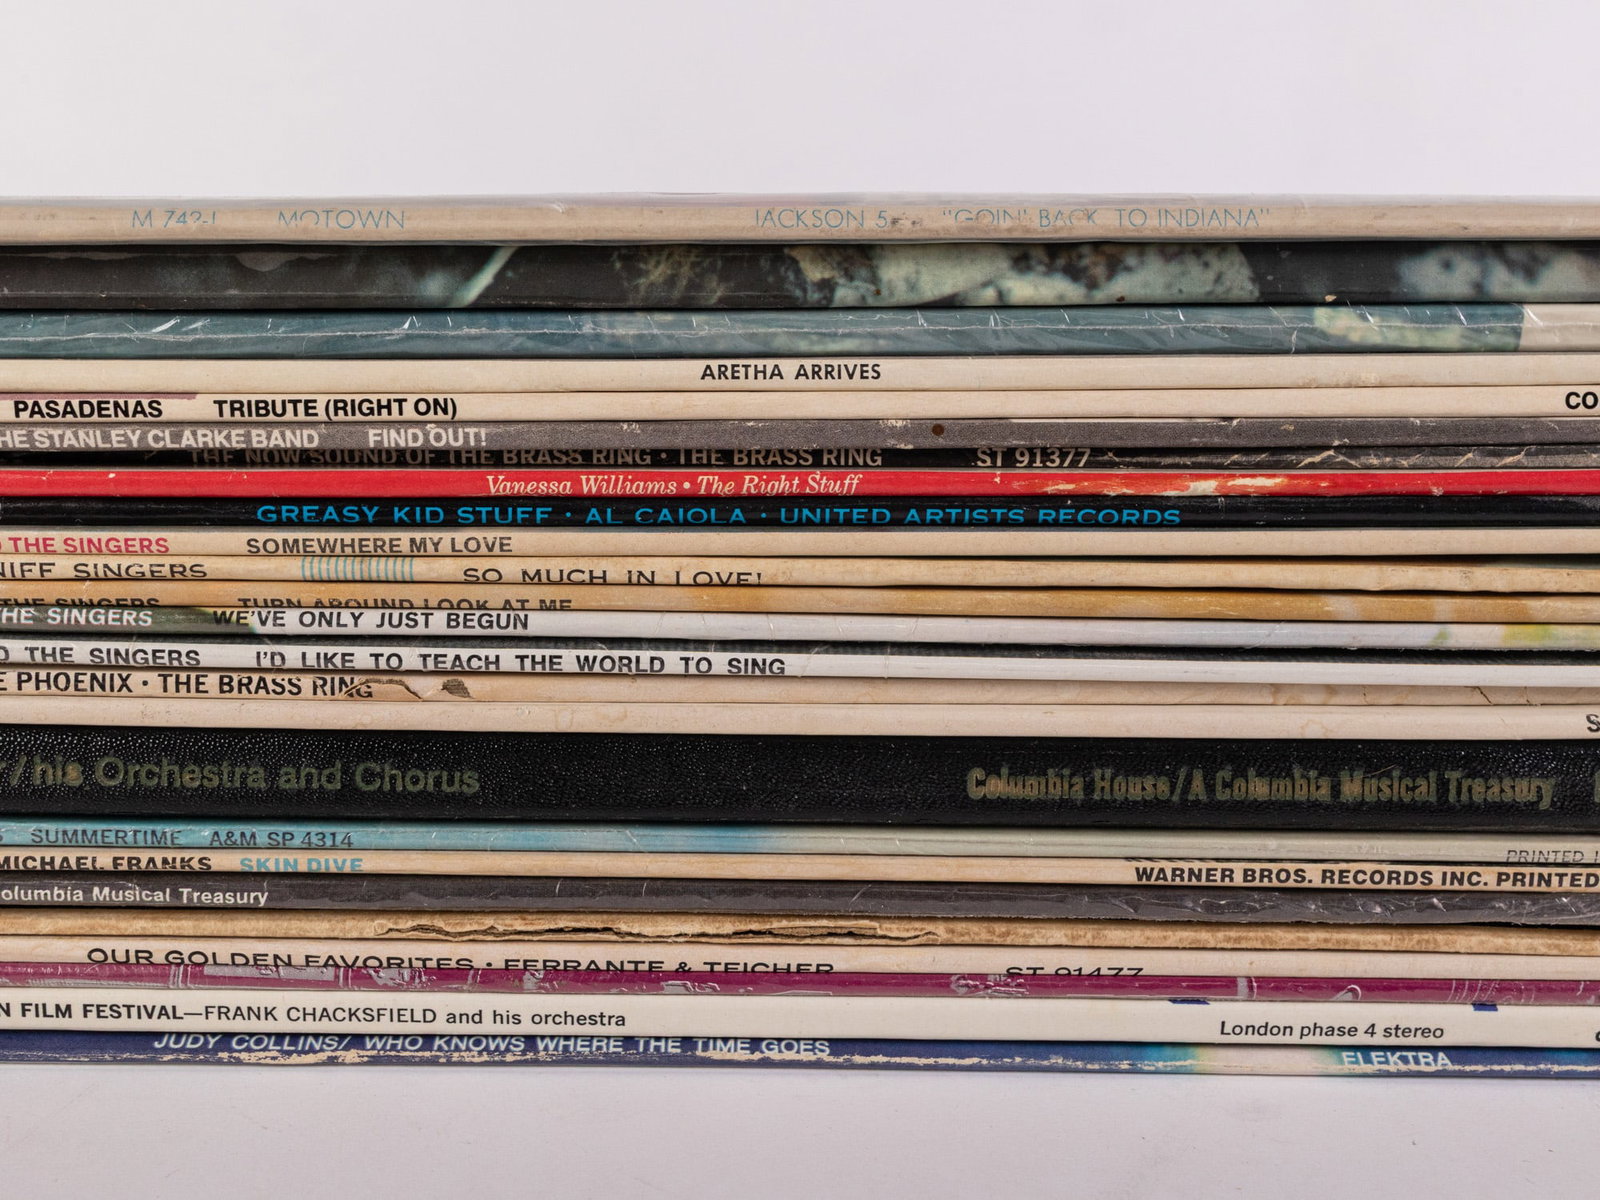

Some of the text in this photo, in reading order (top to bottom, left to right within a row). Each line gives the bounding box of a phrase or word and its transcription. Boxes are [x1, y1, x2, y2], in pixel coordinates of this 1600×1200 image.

[131, 210, 152, 228] M
[279, 210, 405, 229] MOTOWN
[1039, 209, 1098, 227] BACK
[1115, 208, 1147, 227] TO
[1158, 208, 1270, 227] INDIANA"
[700, 363, 881, 380] ARETHA ARRIVES
[14, 400, 163, 418] PASADENAS
[213, 397, 458, 421] TRIBUTE (RIGHT ON)
[34, 429, 141, 448] STANLEY
[148, 429, 246, 448] CLARKE
[251, 429, 319, 448] BAND
[368, 426, 487, 447] FIND OUT!
[191, 449, 882, 466] THE NOW SOUND OF THE BRASS RING THE BRASS RING
[977, 448, 1091, 468] ST 91377
[487, 472, 863, 497] Vanessa Williams The Right Stuff
[257, 505, 1181, 525] GREASY KID STUFF AL CAIOLA UNITED ARTISTS RECORDS
[9, 537, 57, 553] THE
[63, 537, 170, 553] SINGERS
[246, 536, 512, 554] SOMEWHERE MY LOVE
[73, 562, 208, 578] SINGERS
[463, 568, 503, 583] SO
[522, 568, 608, 583] MUCH
[627, 570, 656, 584] IN
[0, 608, 153, 626] HE SINGERS
[212, 611, 528, 630] WE'VE ONLY JUST BEGUN
[25, 647, 75, 662] THE
[90, 648, 200, 666] SINGERS
[256, 651, 785, 675] I'D LIKE TO TEACH THE WORLD TO SING
[17, 672, 133, 693] PHOENIX
[158, 674, 208, 693] THE
[219, 675, 301, 695] BRASS
[313, 677, 373, 698] RING
[96, 756, 266, 788] Orchestra
[278, 760, 341, 790] and
[355, 762, 480, 793] Chorus
[967, 767, 1085, 800] Columbia
[1215, 768, 1331, 801] Columbia
[1340, 769, 1438, 801] Musical
[1445, 770, 1556, 810] Treasury
[31, 829, 354, 848] SUMMERTIME A&M SP 4314
[112, 856, 212, 870] FRANKS
[240, 857, 363, 873] SKIN DIVE
[1506, 850, 1584, 863] PRINTED
[1135, 867, 1600, 888] WARNER BROS. RECORDS INC. PRINTED
[93, 887, 170, 903] Musical
[179, 888, 268, 907] Treasury
[87, 948, 153, 964] OUR
[165, 950, 296, 966] GOLDEN
[304, 955, 474, 969] FAVORITES
[504, 959, 664, 972] FERRANTE
[21, 1003, 72, 1018] FILM
[287, 1006, 436, 1023] CHACKSFIELD
[446, 1008, 482, 1025] and
[493, 1009, 521, 1025] his
[531, 1010, 625, 1027] orchestra
[1220, 1021, 1444, 1042] London phase 4 stereo
[154, 1033, 221, 1049] JUDY
[365, 1035, 424, 1051] WHO
[434, 1036, 525, 1051] KNOWS
[536, 1037, 627, 1053] WHERE
[638, 1038, 682, 1053] THE
[694, 1038, 752, 1054] TIME
[762, 1039, 830, 1055] GOES
[1342, 1051, 1452, 1066] ELEKTRA
